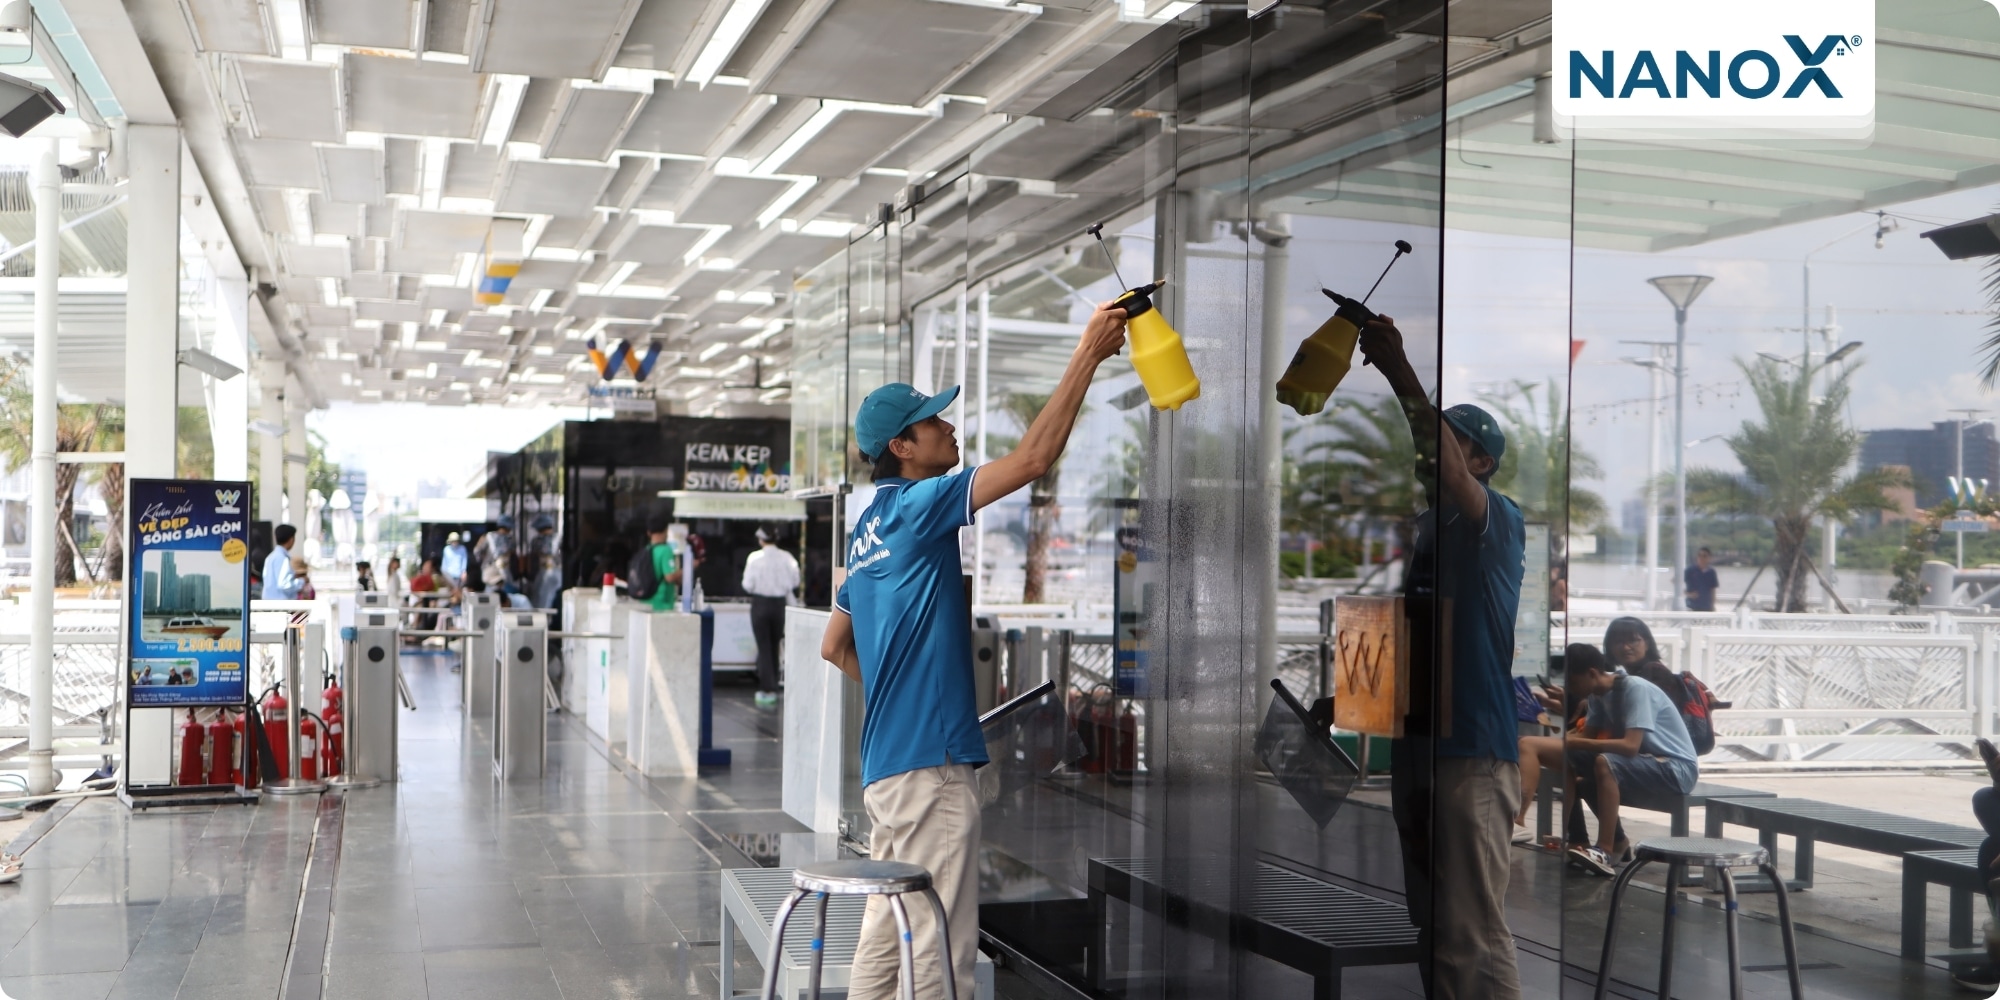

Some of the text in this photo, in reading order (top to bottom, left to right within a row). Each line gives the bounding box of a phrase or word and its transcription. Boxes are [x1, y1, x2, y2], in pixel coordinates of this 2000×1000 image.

[685, 443, 730, 463] KEM
[685, 471, 791, 492] SINGAPOR
[142, 520, 242, 546] SÔNG SÀI GÒN
